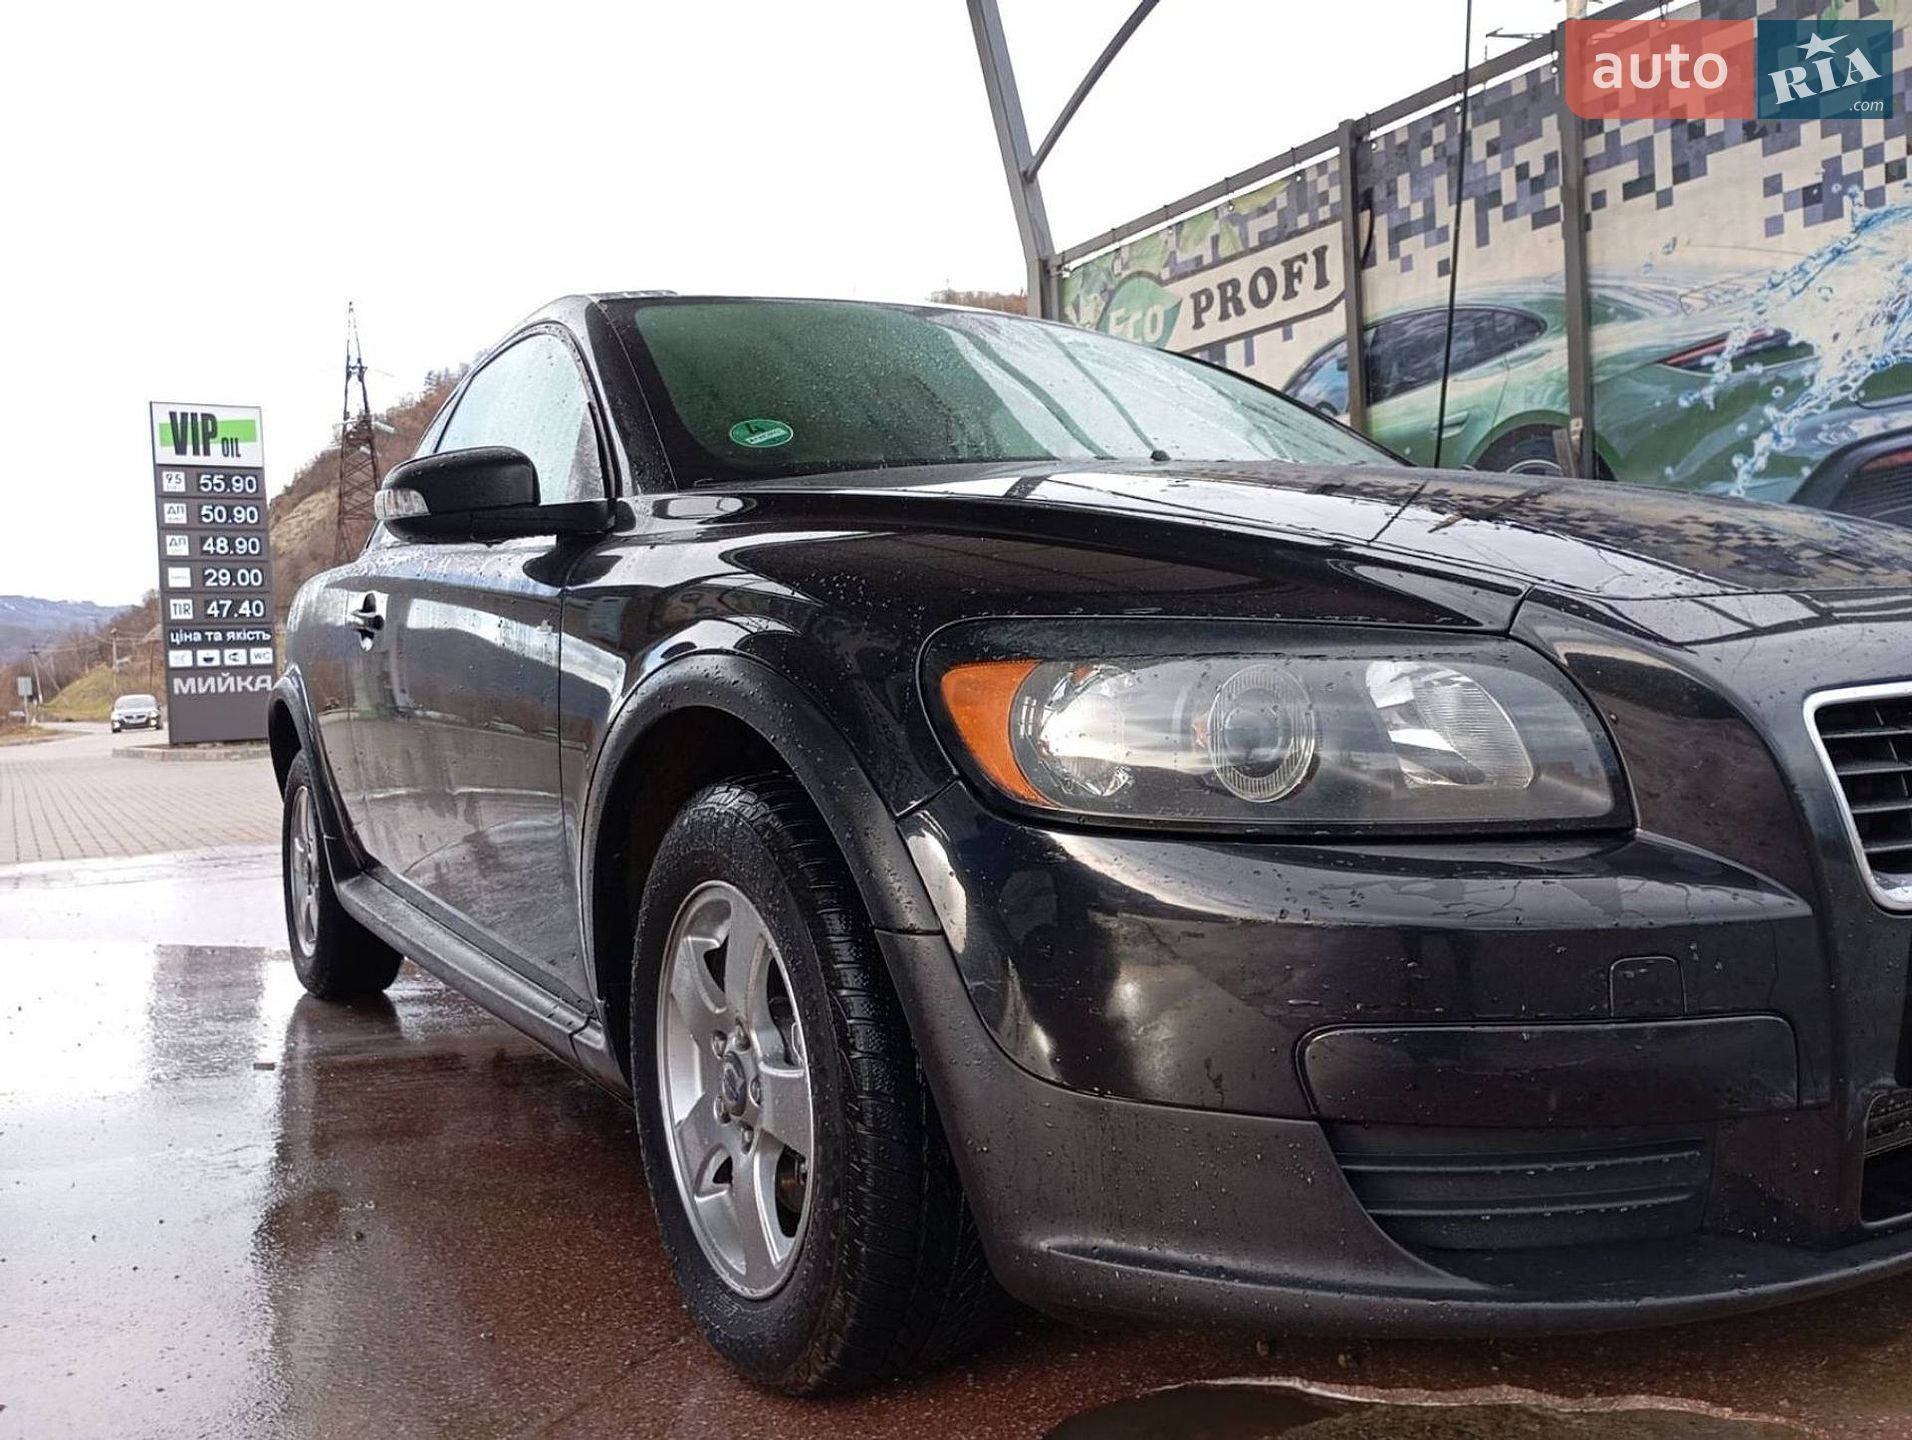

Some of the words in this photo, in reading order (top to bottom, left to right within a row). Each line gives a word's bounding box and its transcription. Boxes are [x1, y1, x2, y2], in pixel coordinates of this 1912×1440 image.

[1189, 245, 1331, 330] PROFI
[169, 411, 218, 456] VIP
[221, 437, 242, 458] OIL
[165, 473, 182, 485] 95
[199, 474, 257, 493] 55.90
[200, 505, 259, 524] 50.90
[202, 537, 260, 555] 48.90
[203, 568, 263, 587] 29.00
[171, 601, 191, 616] TIR
[206, 600, 265, 618] 47.40
[170, 629, 201, 645] ціна
[205, 631, 223, 642] та
[226, 628, 271, 642] якість
[173, 672, 273, 695] МИЙКА
